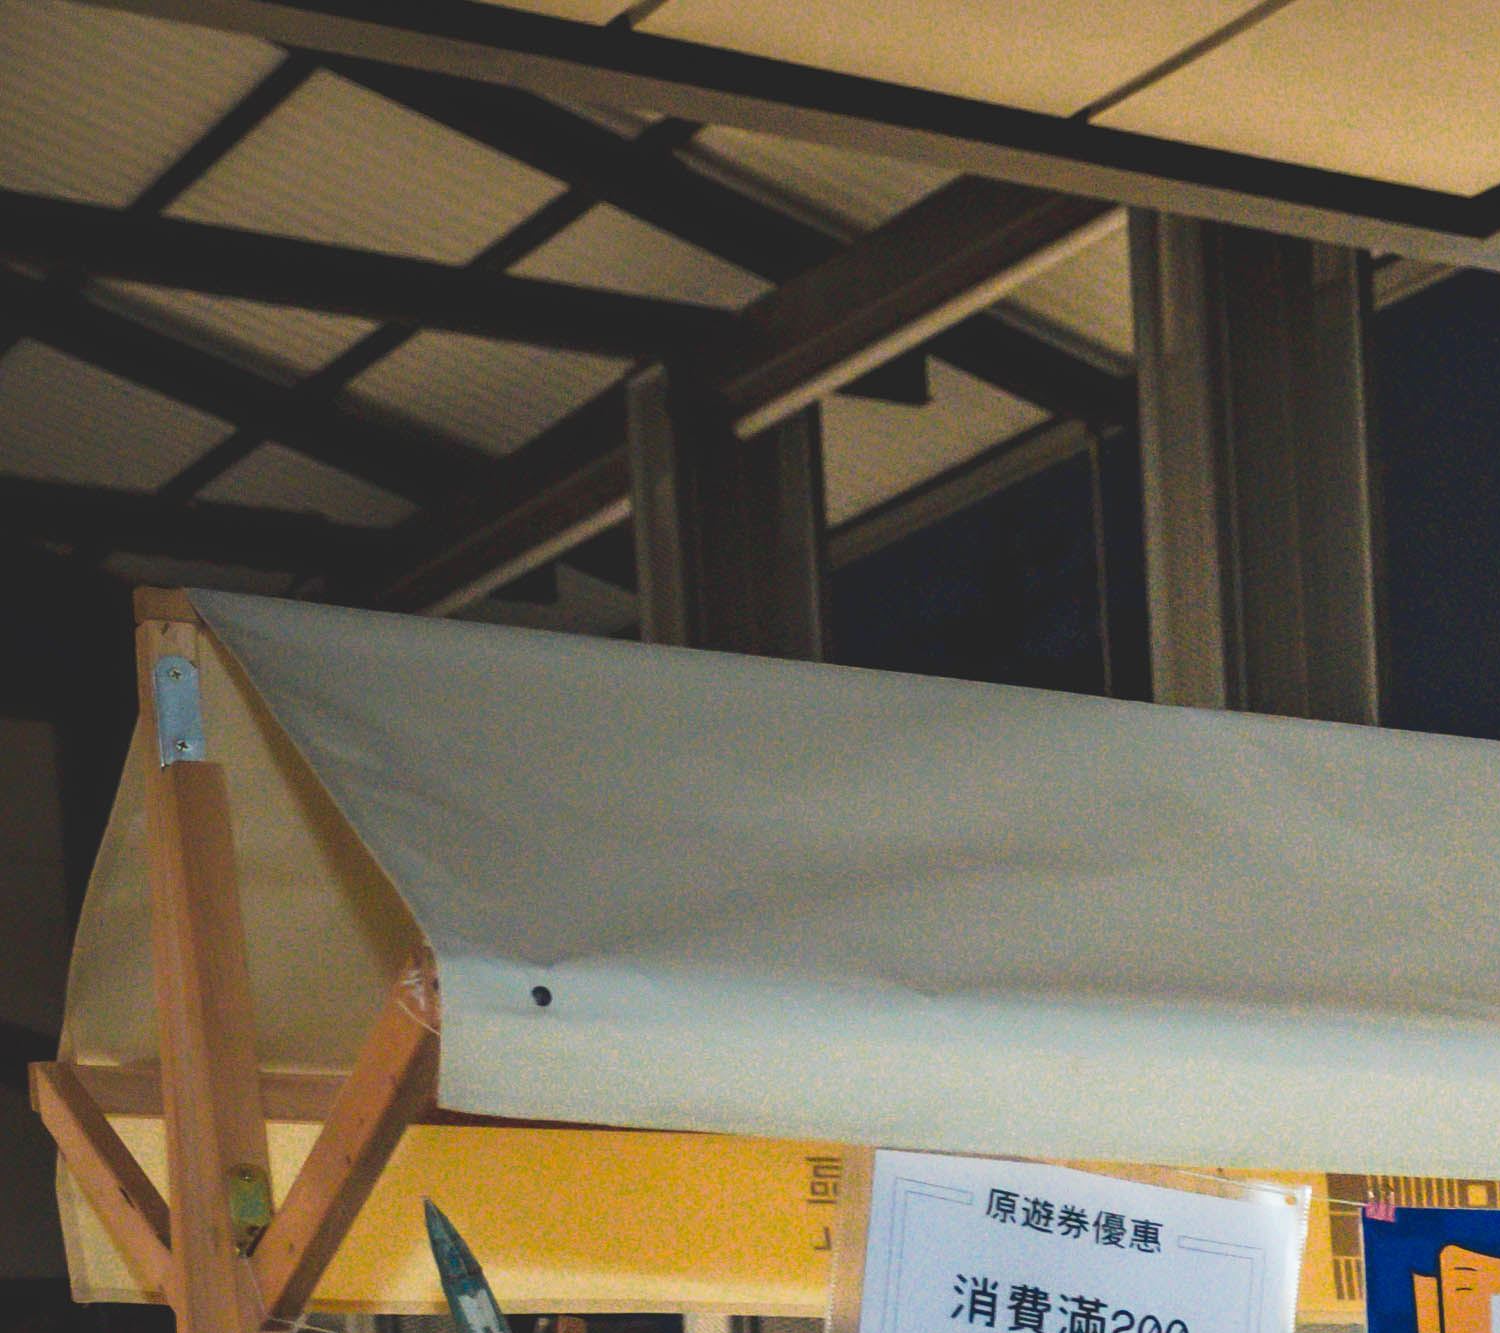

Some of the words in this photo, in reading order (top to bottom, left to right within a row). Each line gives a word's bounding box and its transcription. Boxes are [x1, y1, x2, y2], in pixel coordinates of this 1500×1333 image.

[985, 1188, 1164, 1255] 原遊券優惠
